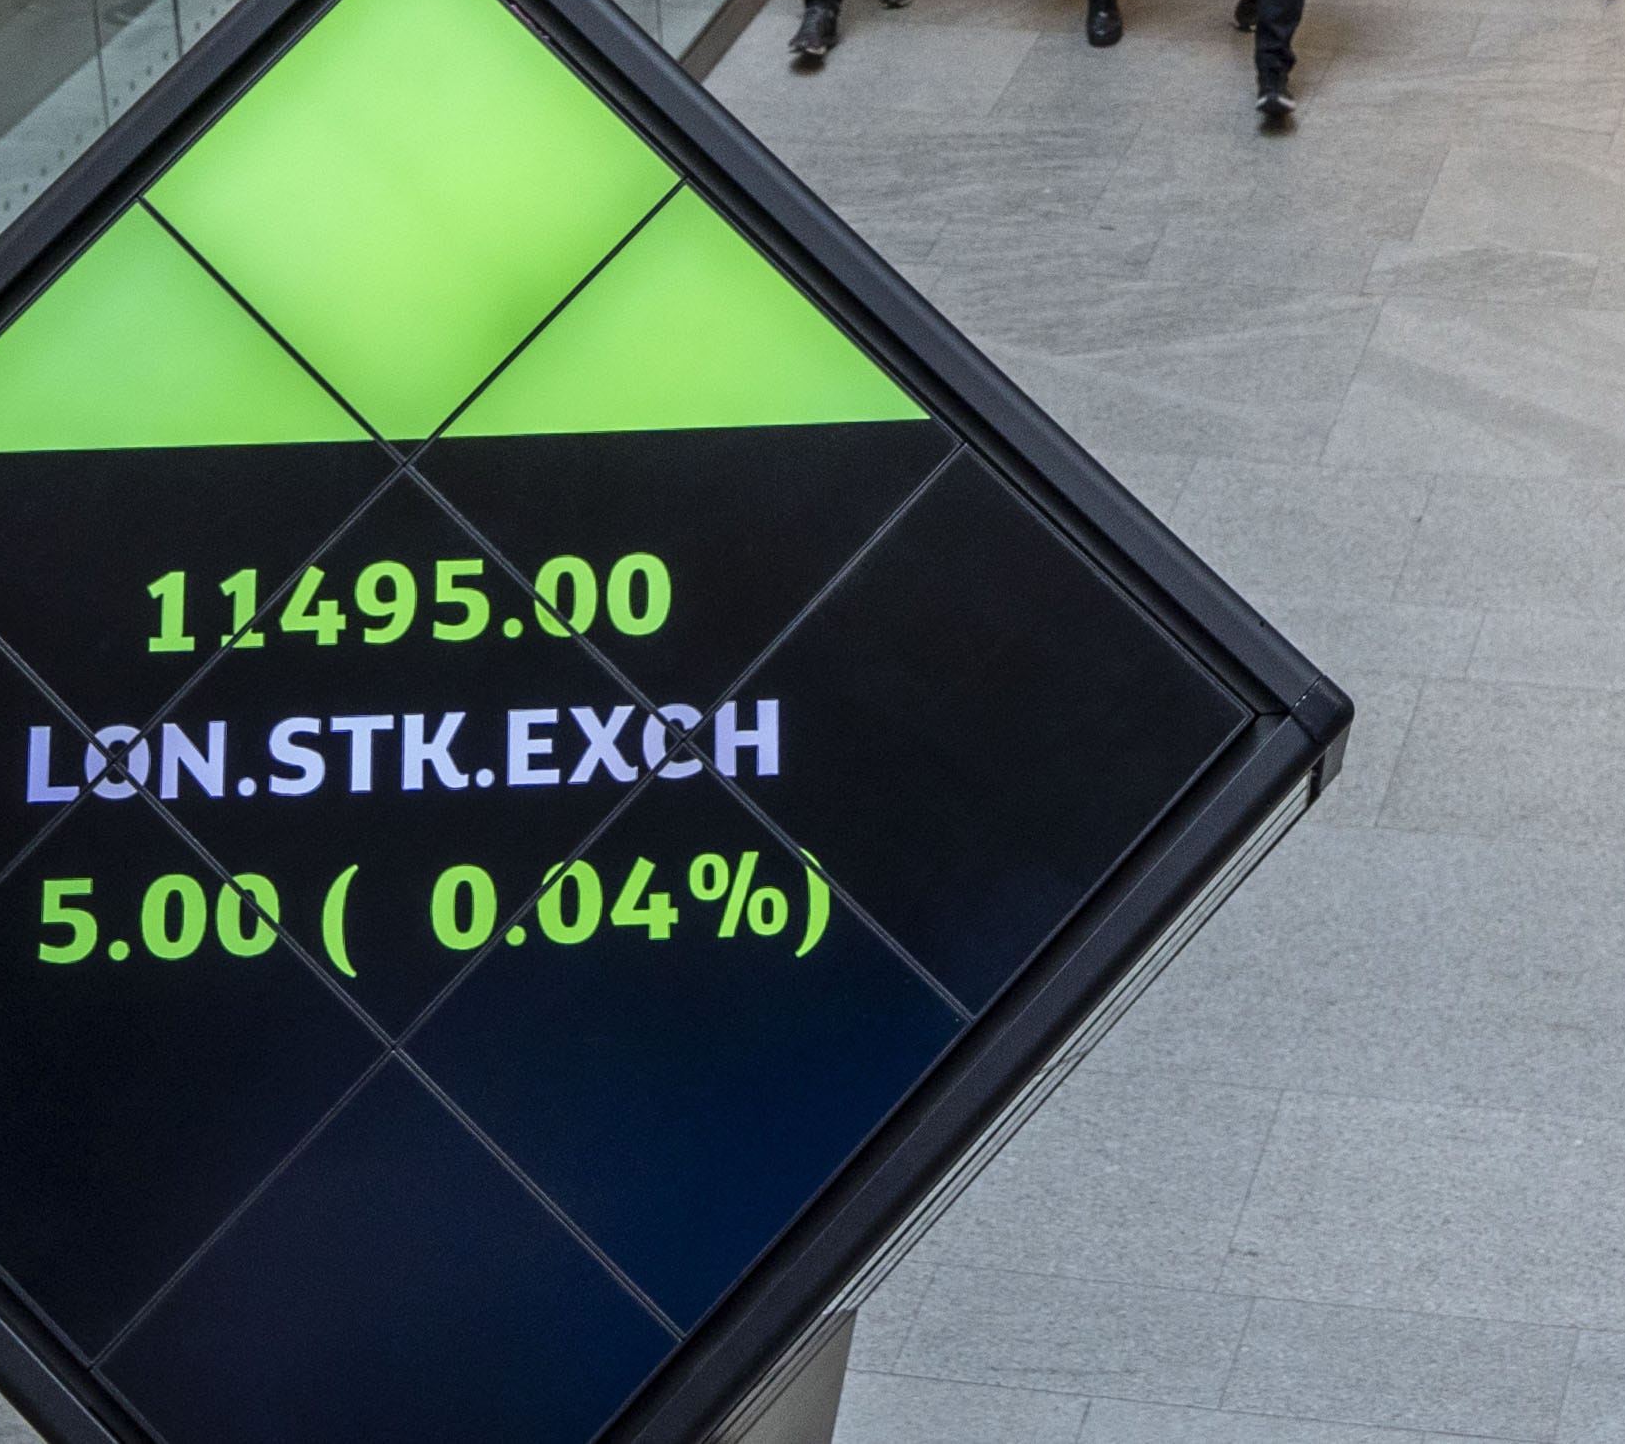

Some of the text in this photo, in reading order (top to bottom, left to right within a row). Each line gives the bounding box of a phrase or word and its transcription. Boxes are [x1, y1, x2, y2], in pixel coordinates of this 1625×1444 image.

[147, 551, 672, 653] 11495.00
[26, 698, 780, 804] LON.STK.EXCH
[38, 872, 281, 965] 5.00
